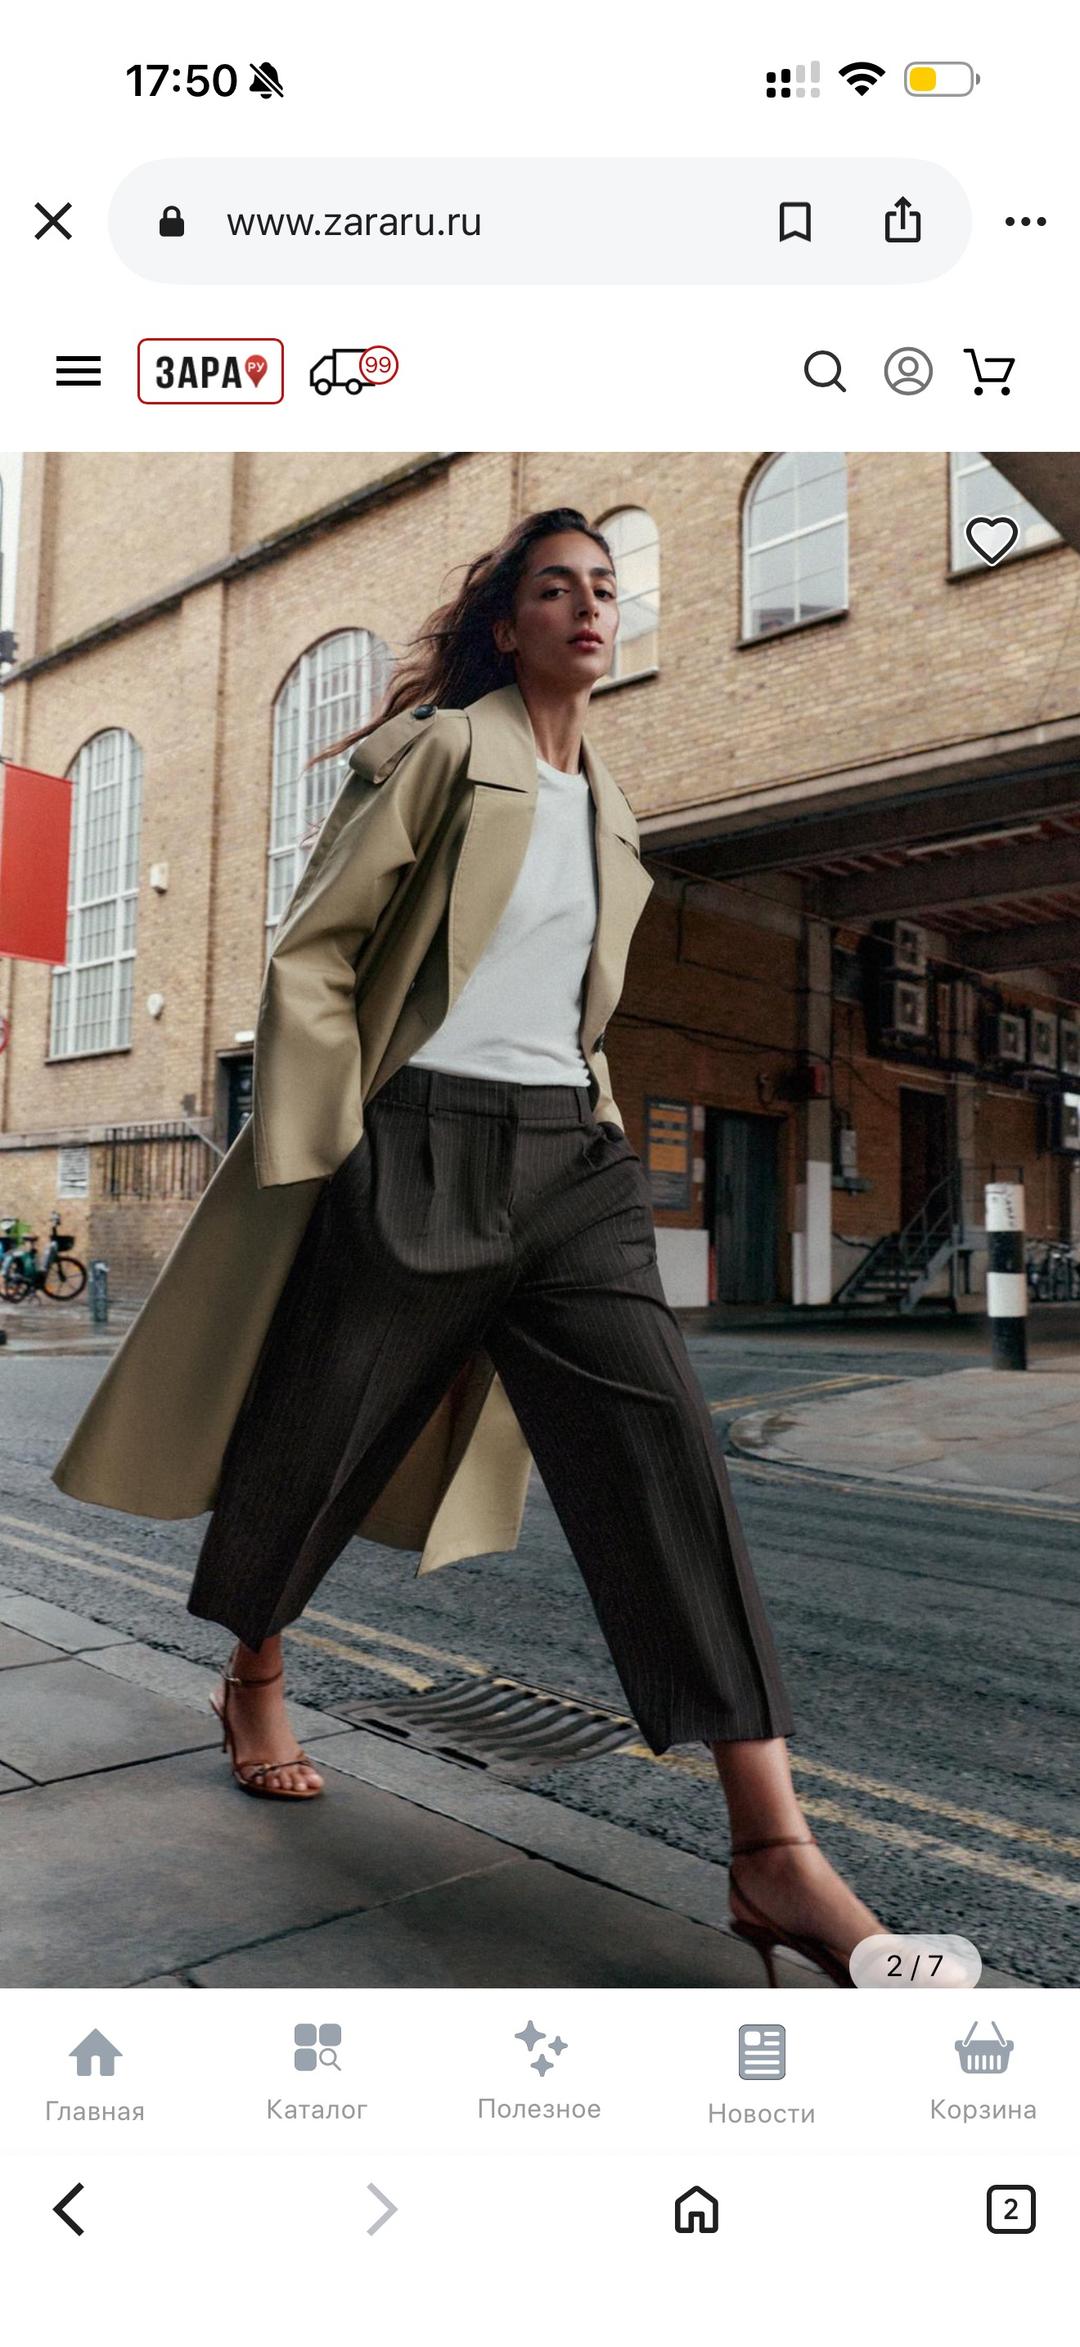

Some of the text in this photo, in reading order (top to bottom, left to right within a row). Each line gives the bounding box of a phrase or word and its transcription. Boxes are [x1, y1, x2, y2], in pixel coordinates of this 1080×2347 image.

[126, 63, 238, 98] 17:50
[226, 213, 481, 237] www.zararu.ru
[365, 356, 391, 373] 99
[887, 1954, 903, 1977] 2
[928, 1954, 944, 1977] 7
[46, 2100, 144, 2121] Главная
[267, 2098, 368, 2120] Каталог
[478, 2098, 601, 2119] Полезное
[709, 2103, 815, 2124] Новости
[931, 2099, 1036, 2124] Корзина
[1003, 2197, 1019, 2220] 2
